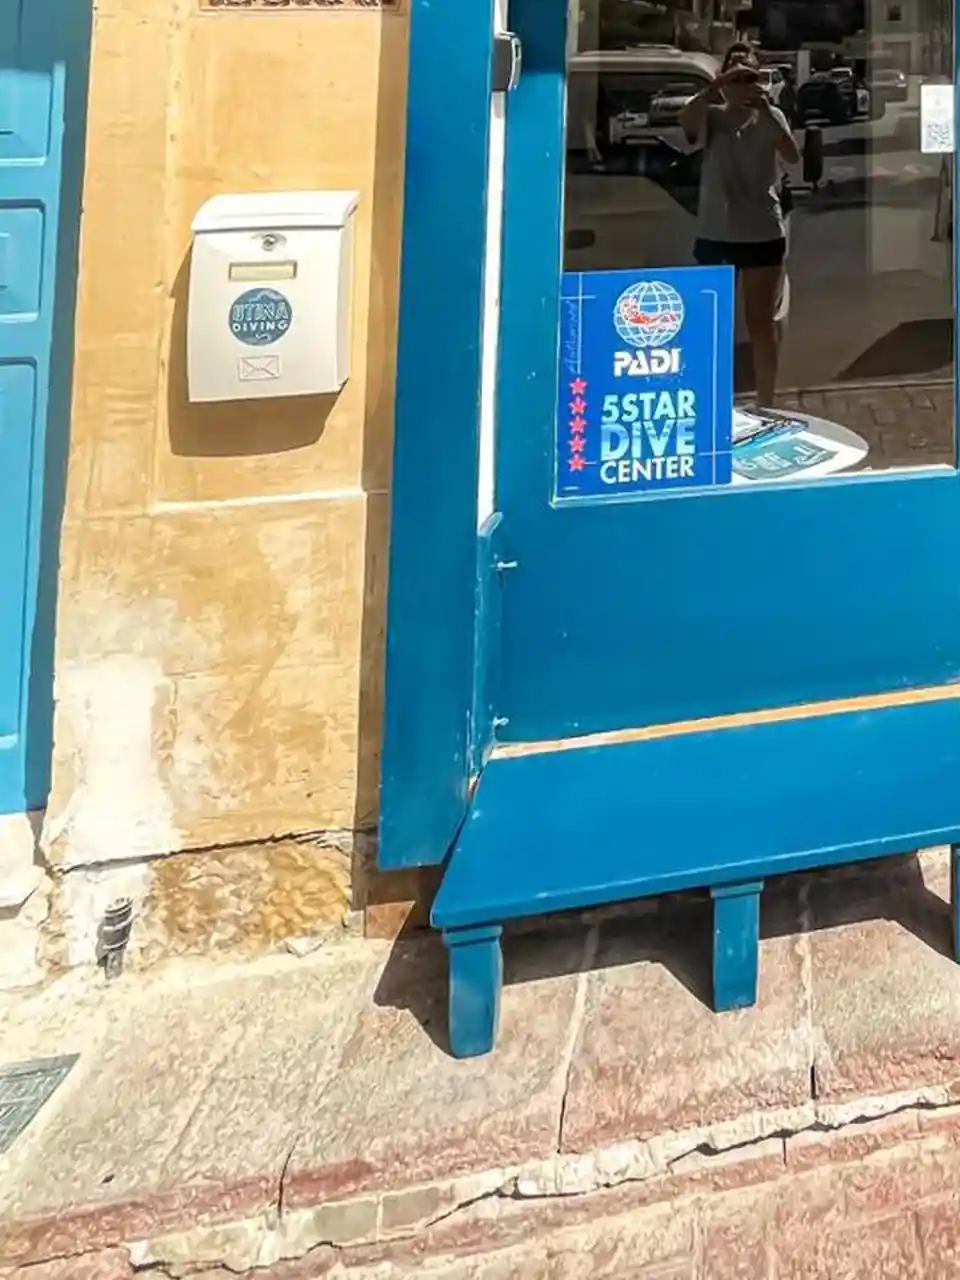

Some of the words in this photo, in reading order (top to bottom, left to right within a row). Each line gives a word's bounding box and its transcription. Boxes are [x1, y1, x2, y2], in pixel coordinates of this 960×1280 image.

[233, 302, 289, 321] UTINA
[233, 320, 289, 332] DIVING
[614, 348, 681, 377] PADI
[601, 418, 696, 461] DIVE
[600, 456, 694, 485] CENTER
